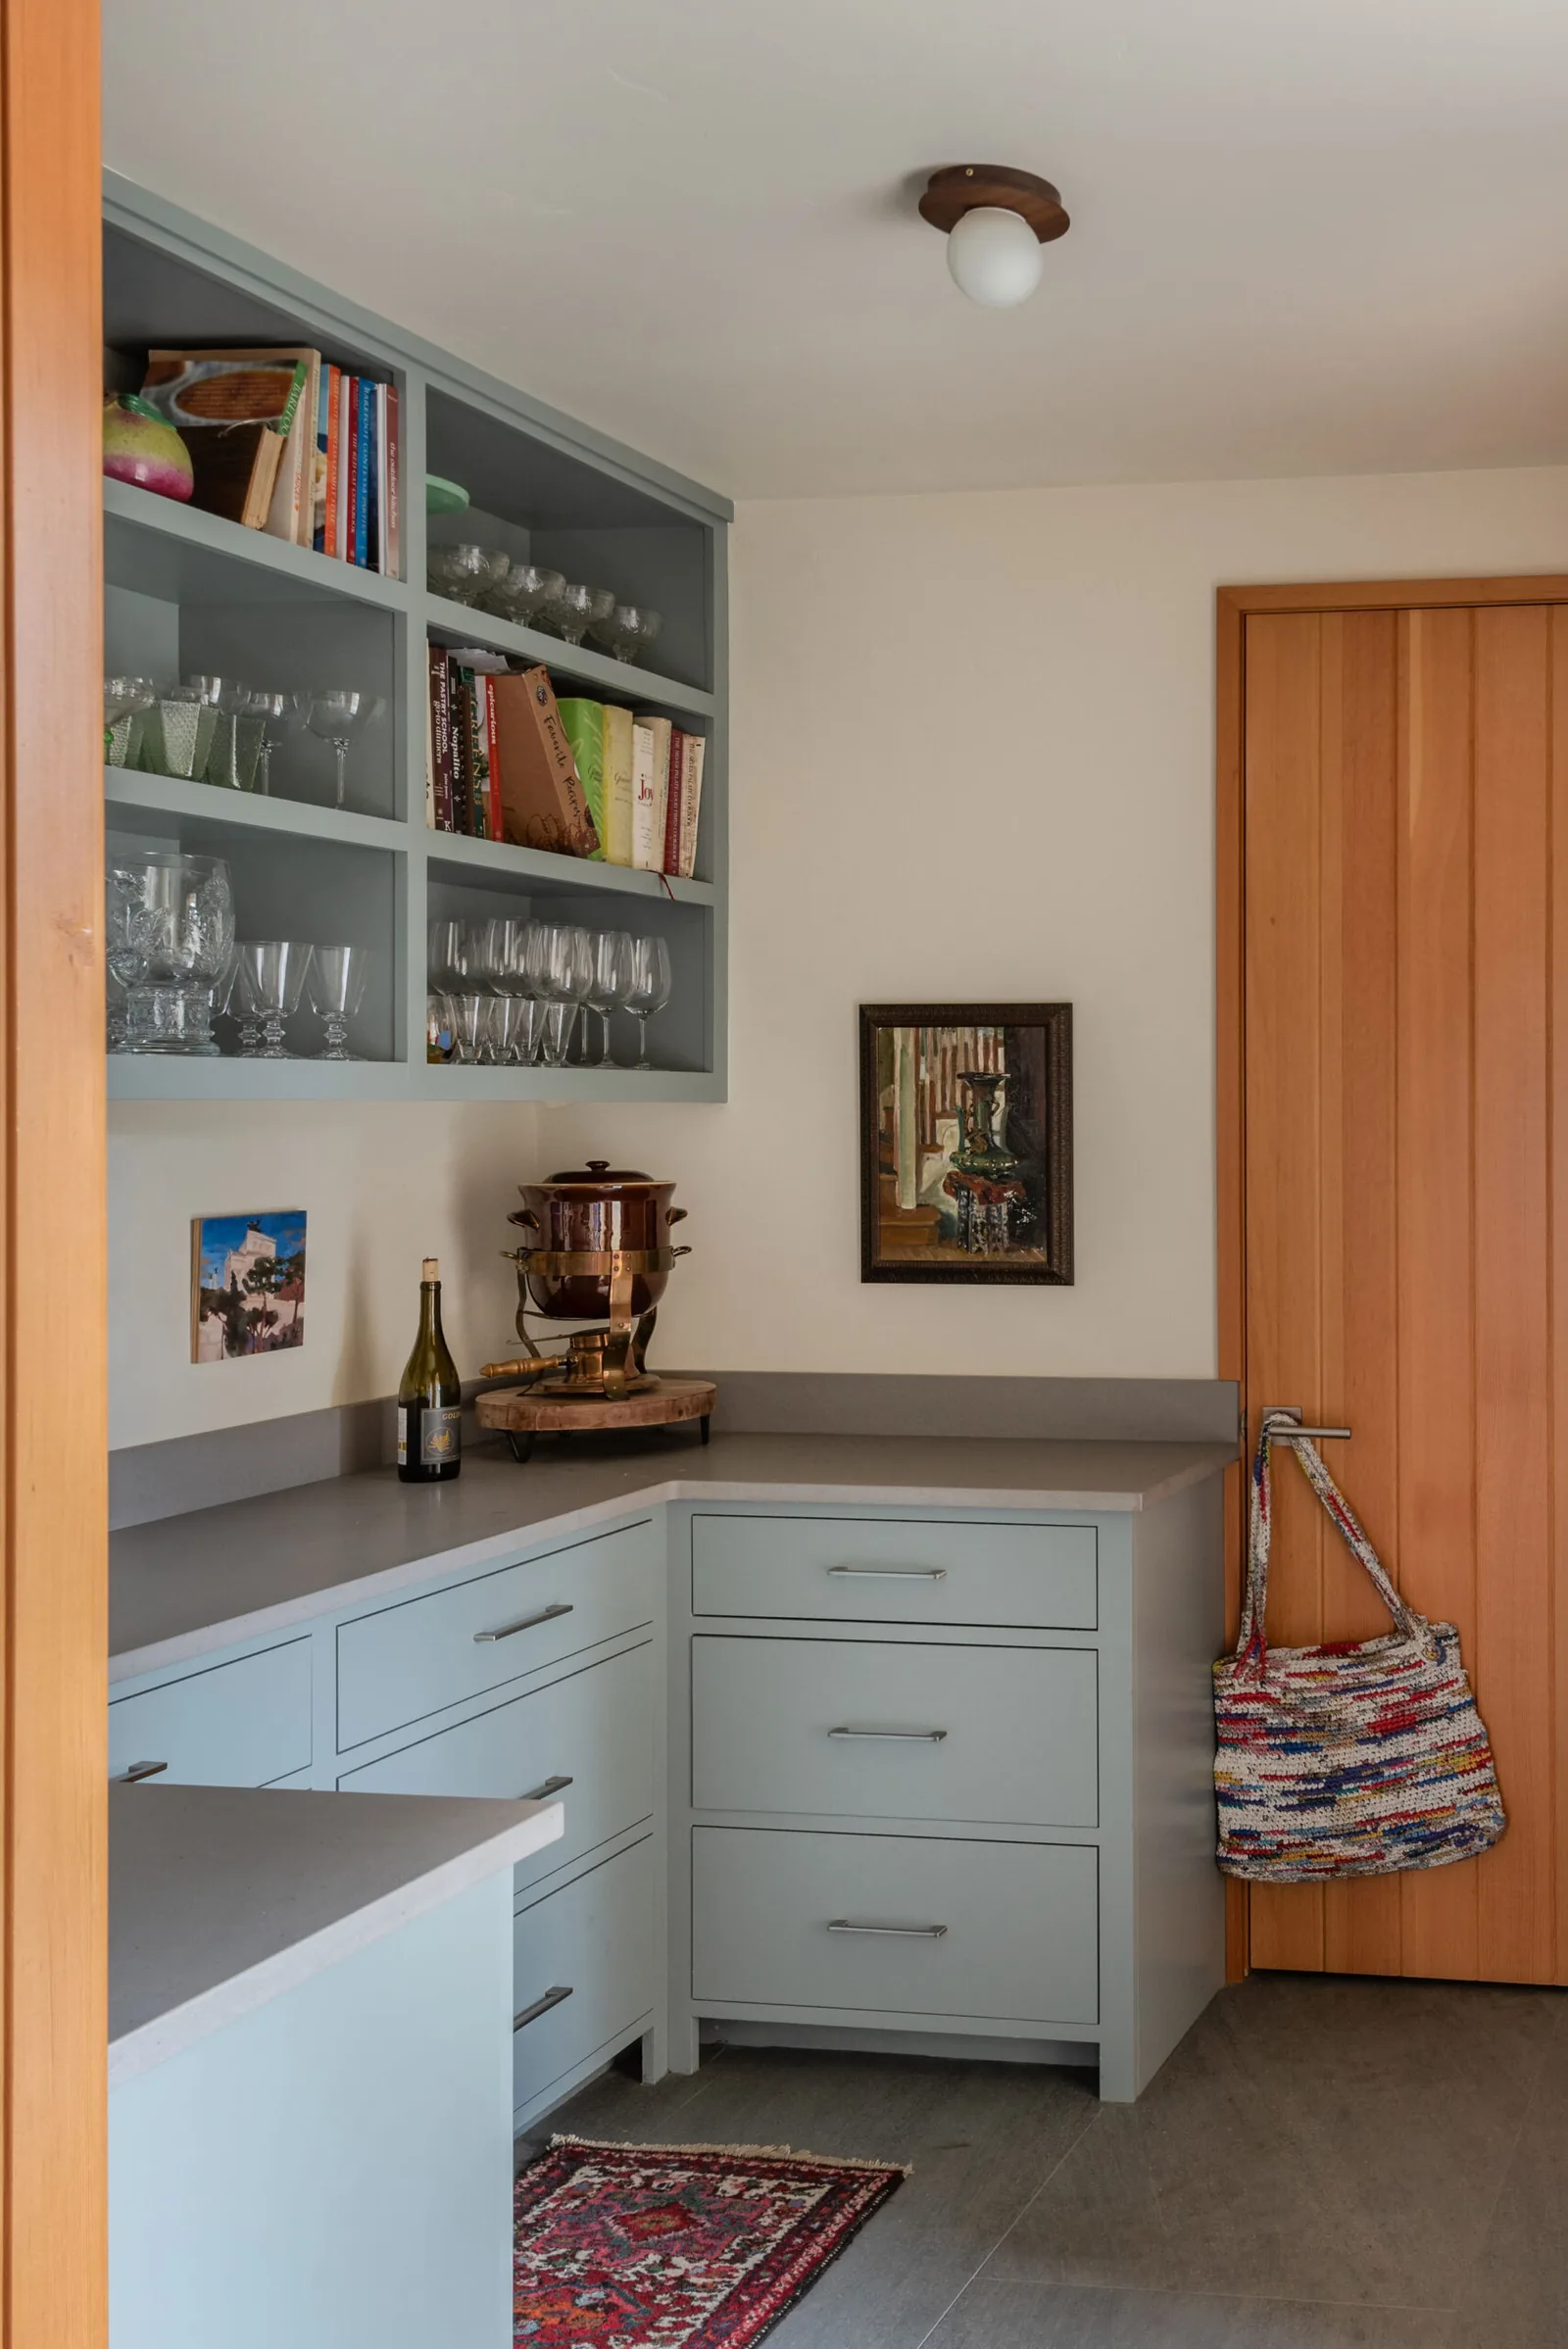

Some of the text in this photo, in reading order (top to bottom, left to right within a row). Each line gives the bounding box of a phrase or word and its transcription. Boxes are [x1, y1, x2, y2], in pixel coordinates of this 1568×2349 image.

[281, 383, 301, 436] BAREFOO
[488, 683, 497, 745] epicurious
[451, 726, 461, 779] Nopalito
[470, 700, 481, 789] GREENS
